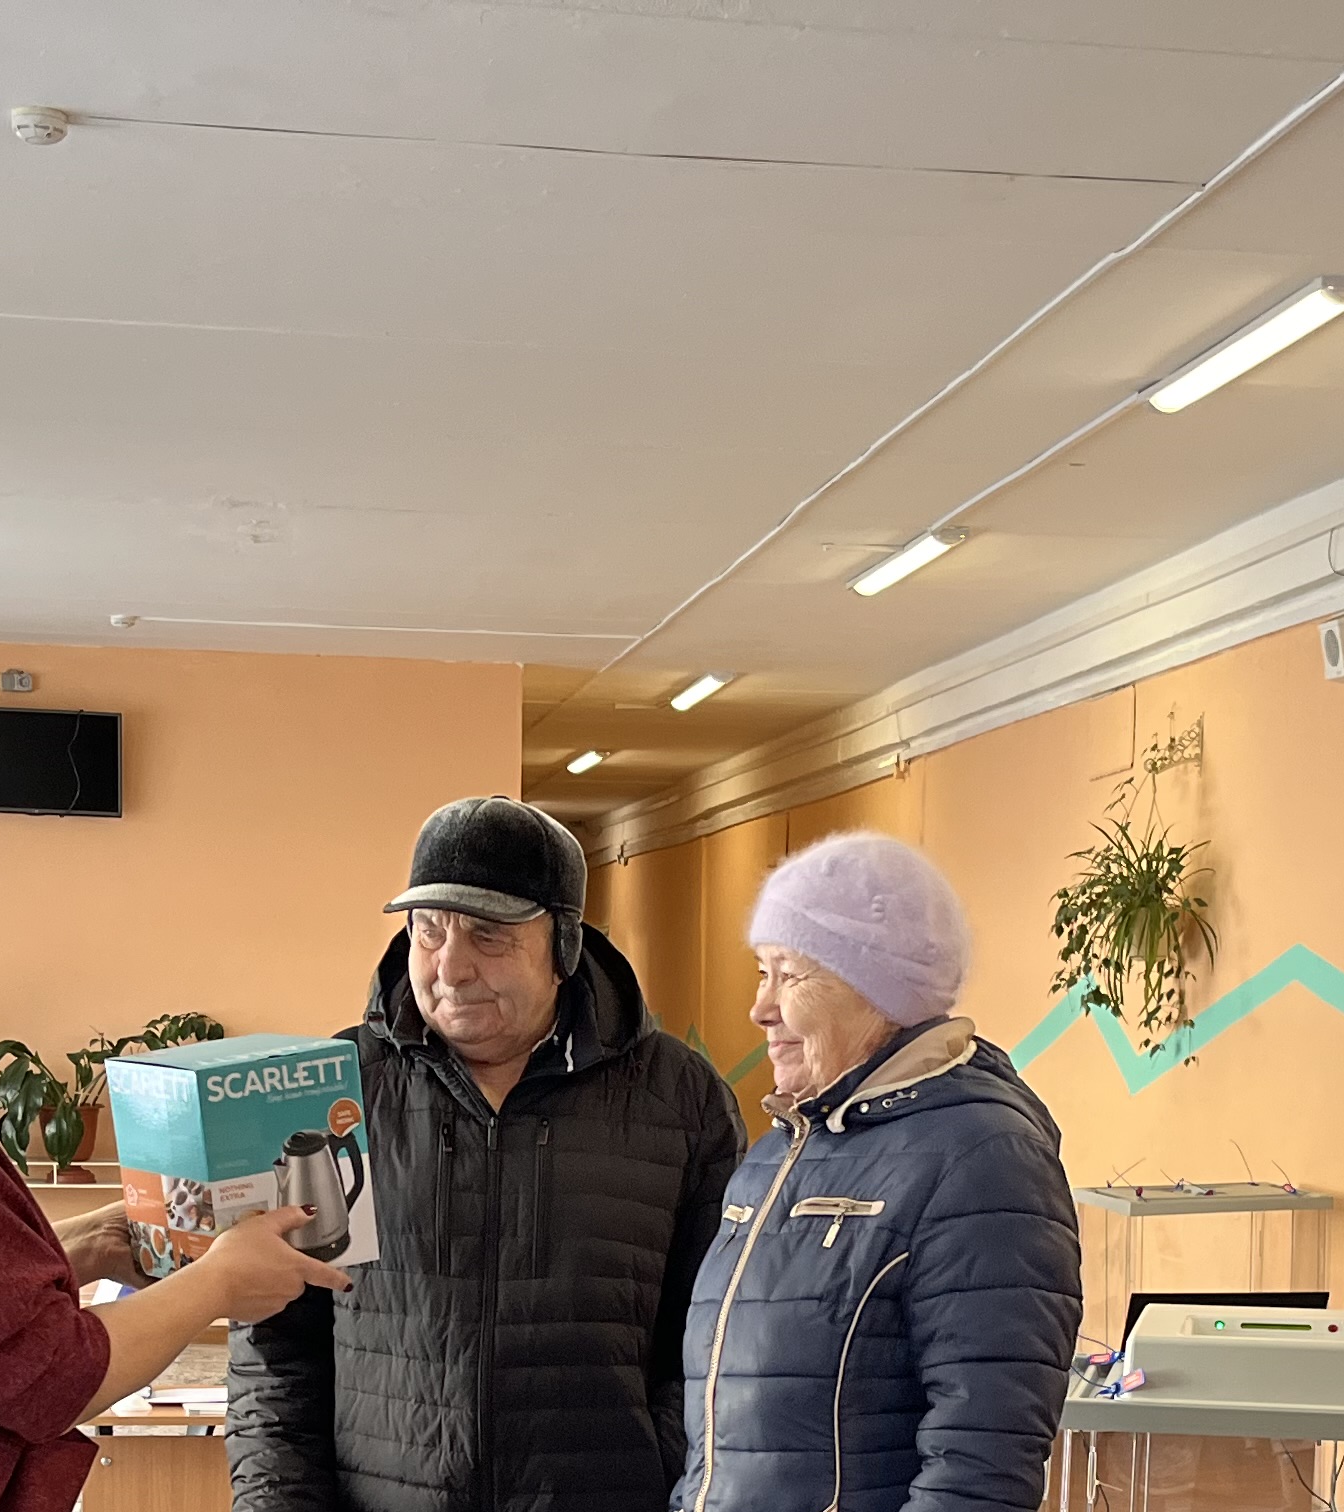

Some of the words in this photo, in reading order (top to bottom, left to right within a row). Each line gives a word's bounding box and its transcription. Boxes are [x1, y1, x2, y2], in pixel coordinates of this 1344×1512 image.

[206, 1055, 346, 1102] SCARLETT
[219, 1182, 254, 1194] NOTHING
[220, 1192, 245, 1202] EXTRA
